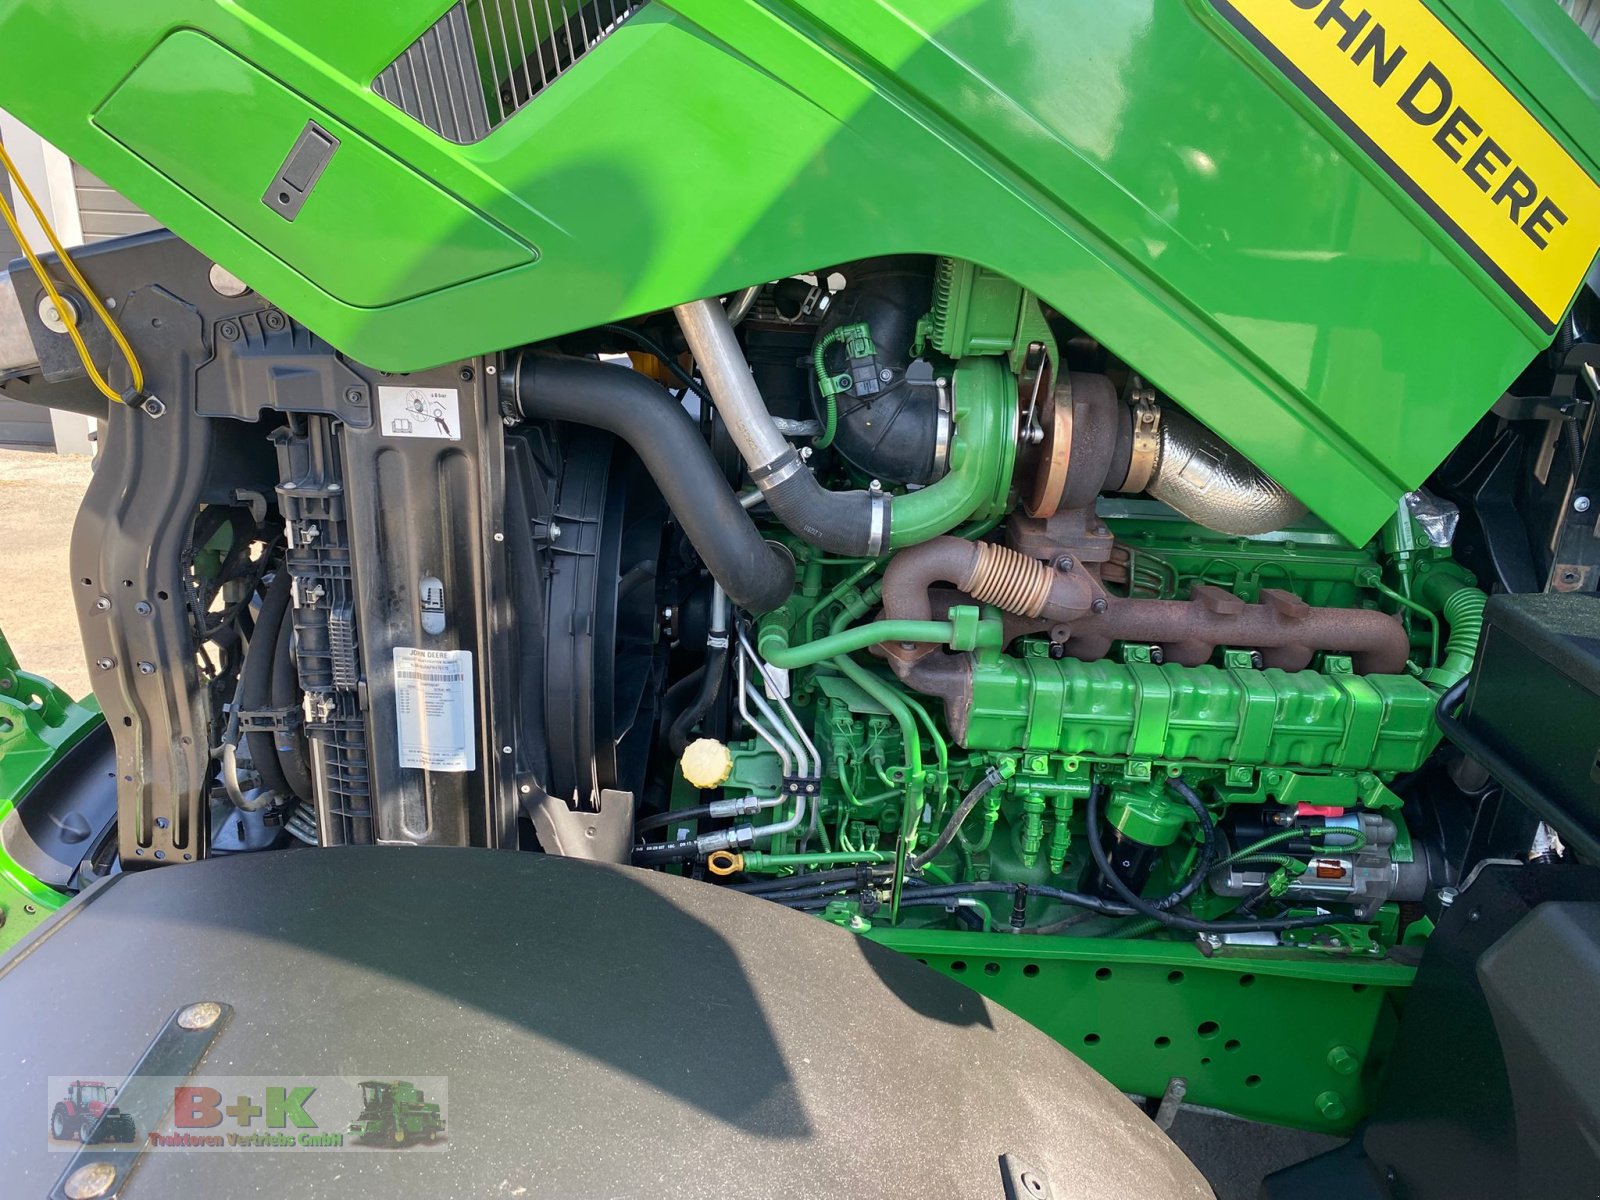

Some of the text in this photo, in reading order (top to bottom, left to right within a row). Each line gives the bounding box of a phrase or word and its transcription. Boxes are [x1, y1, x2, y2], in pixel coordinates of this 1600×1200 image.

[1290, 0, 1569, 251] HN DEERE
[409, 649, 448, 659] JOHN DEERE
